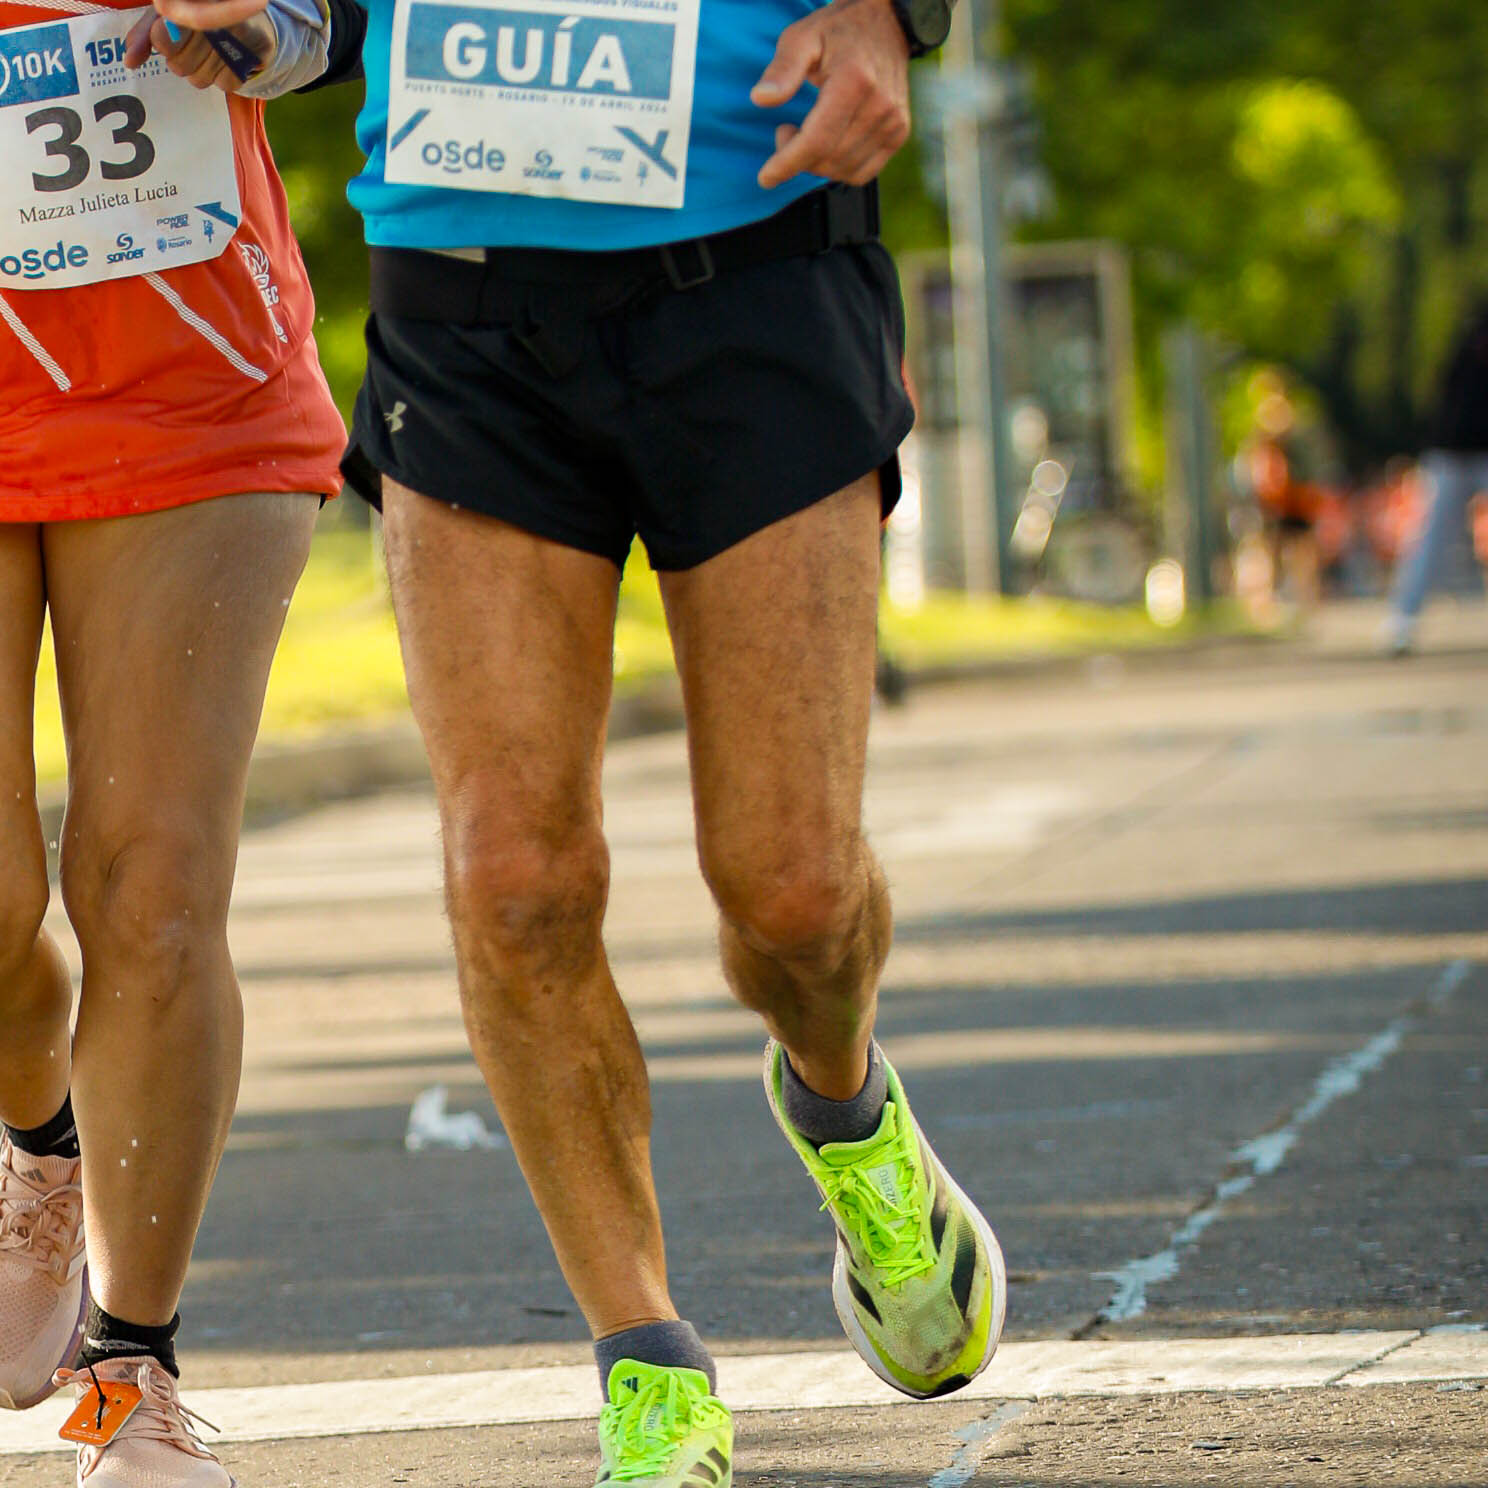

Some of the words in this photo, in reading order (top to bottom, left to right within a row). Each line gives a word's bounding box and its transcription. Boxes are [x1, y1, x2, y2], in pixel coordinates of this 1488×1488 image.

[12, 47, 66, 81] 10K
[442, 16, 632, 93] GUÍA
[25, 94, 156, 193] 33
[421, 139, 506, 174] osde
[19, 202, 75, 224] Mazza
[79, 191, 130, 214] Julieta
[135, 181, 179, 203] Lucia
[0, 240, 89, 279] osde
